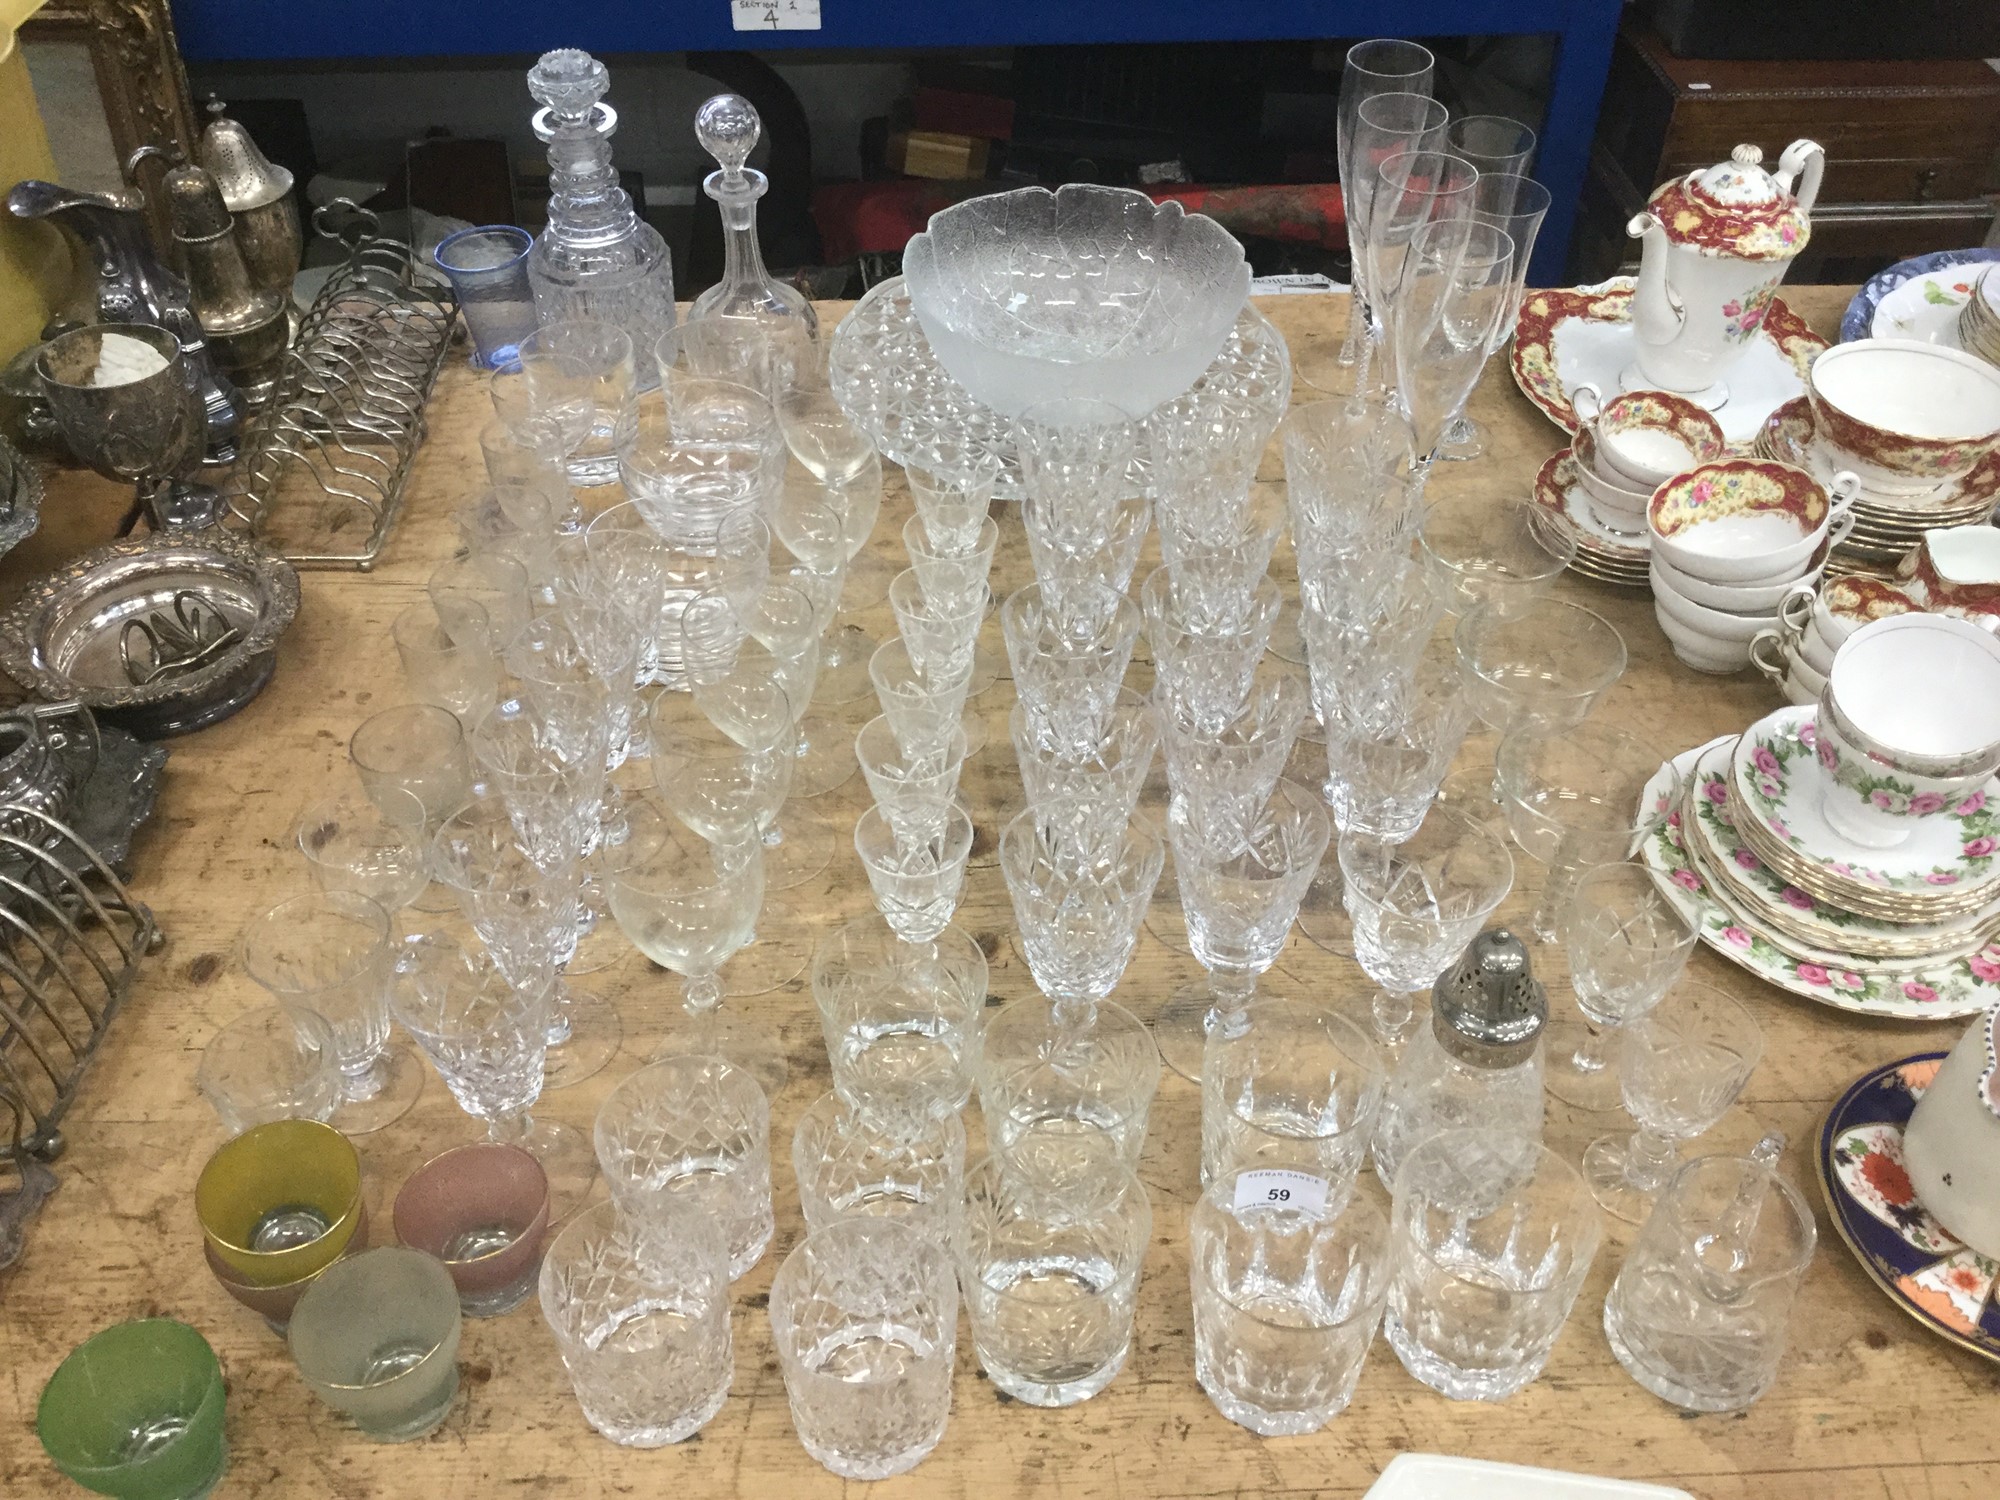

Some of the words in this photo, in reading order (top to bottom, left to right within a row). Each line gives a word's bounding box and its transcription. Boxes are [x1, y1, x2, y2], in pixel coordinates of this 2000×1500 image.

[740, 1, 778, 9] SECTION
[764, 9, 779, 29] 4
[1268, 1189, 1291, 1201] 59
